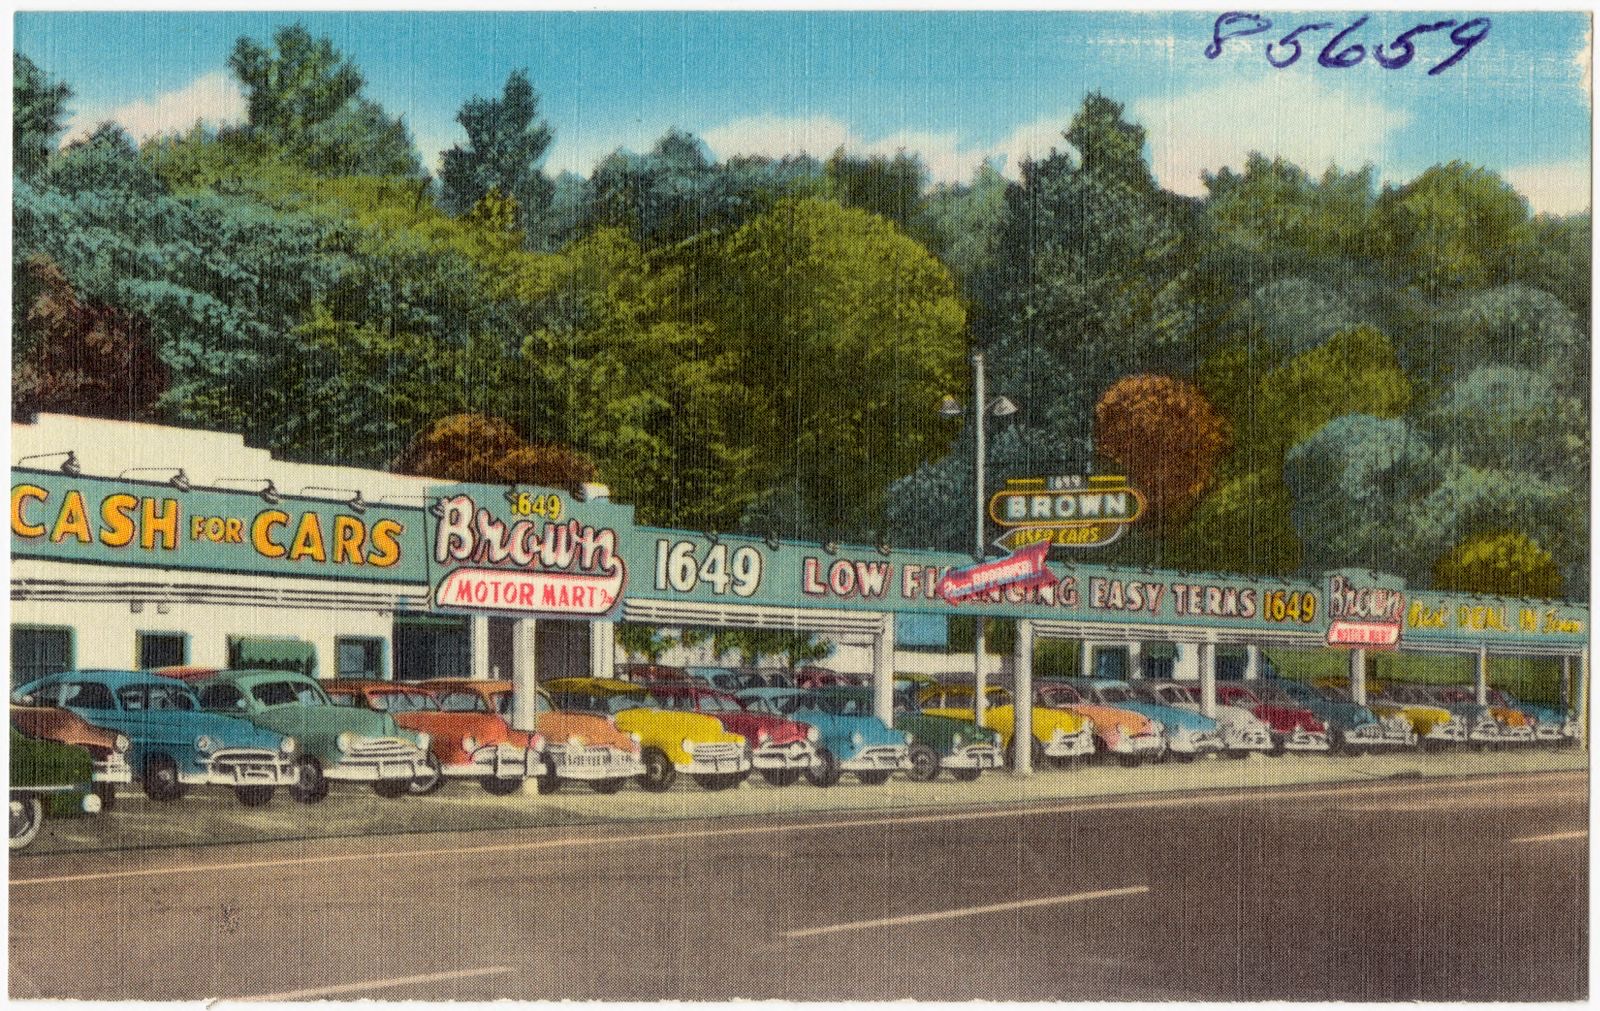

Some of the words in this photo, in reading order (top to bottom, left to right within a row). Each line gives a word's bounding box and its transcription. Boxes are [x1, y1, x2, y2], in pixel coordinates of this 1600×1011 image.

[1204, 11, 1492, 76] 85659
[10, 484, 178, 550] CASH
[190, 515, 243, 543] FOR
[251, 509, 404, 567] CARS
[1006, 494, 1127, 518] BROWN
[434, 494, 622, 572] Brown
[1014, 530, 1054, 549] USED
[1058, 527, 1099, 544] CARS
[456, 579, 535, 605] MOTOR
[541, 583, 597, 608] MART
[656, 539, 764, 597] 1649
[803, 556, 892, 599] LOW
[1090, 576, 1165, 617] EASY
[1171, 582, 1257, 618] TERMS
[1263, 589, 1317, 623] 1649
[1329, 575, 1405, 621] Brown
[1458, 604, 1513, 633] DEAL
[1518, 608, 1538, 633] IN
